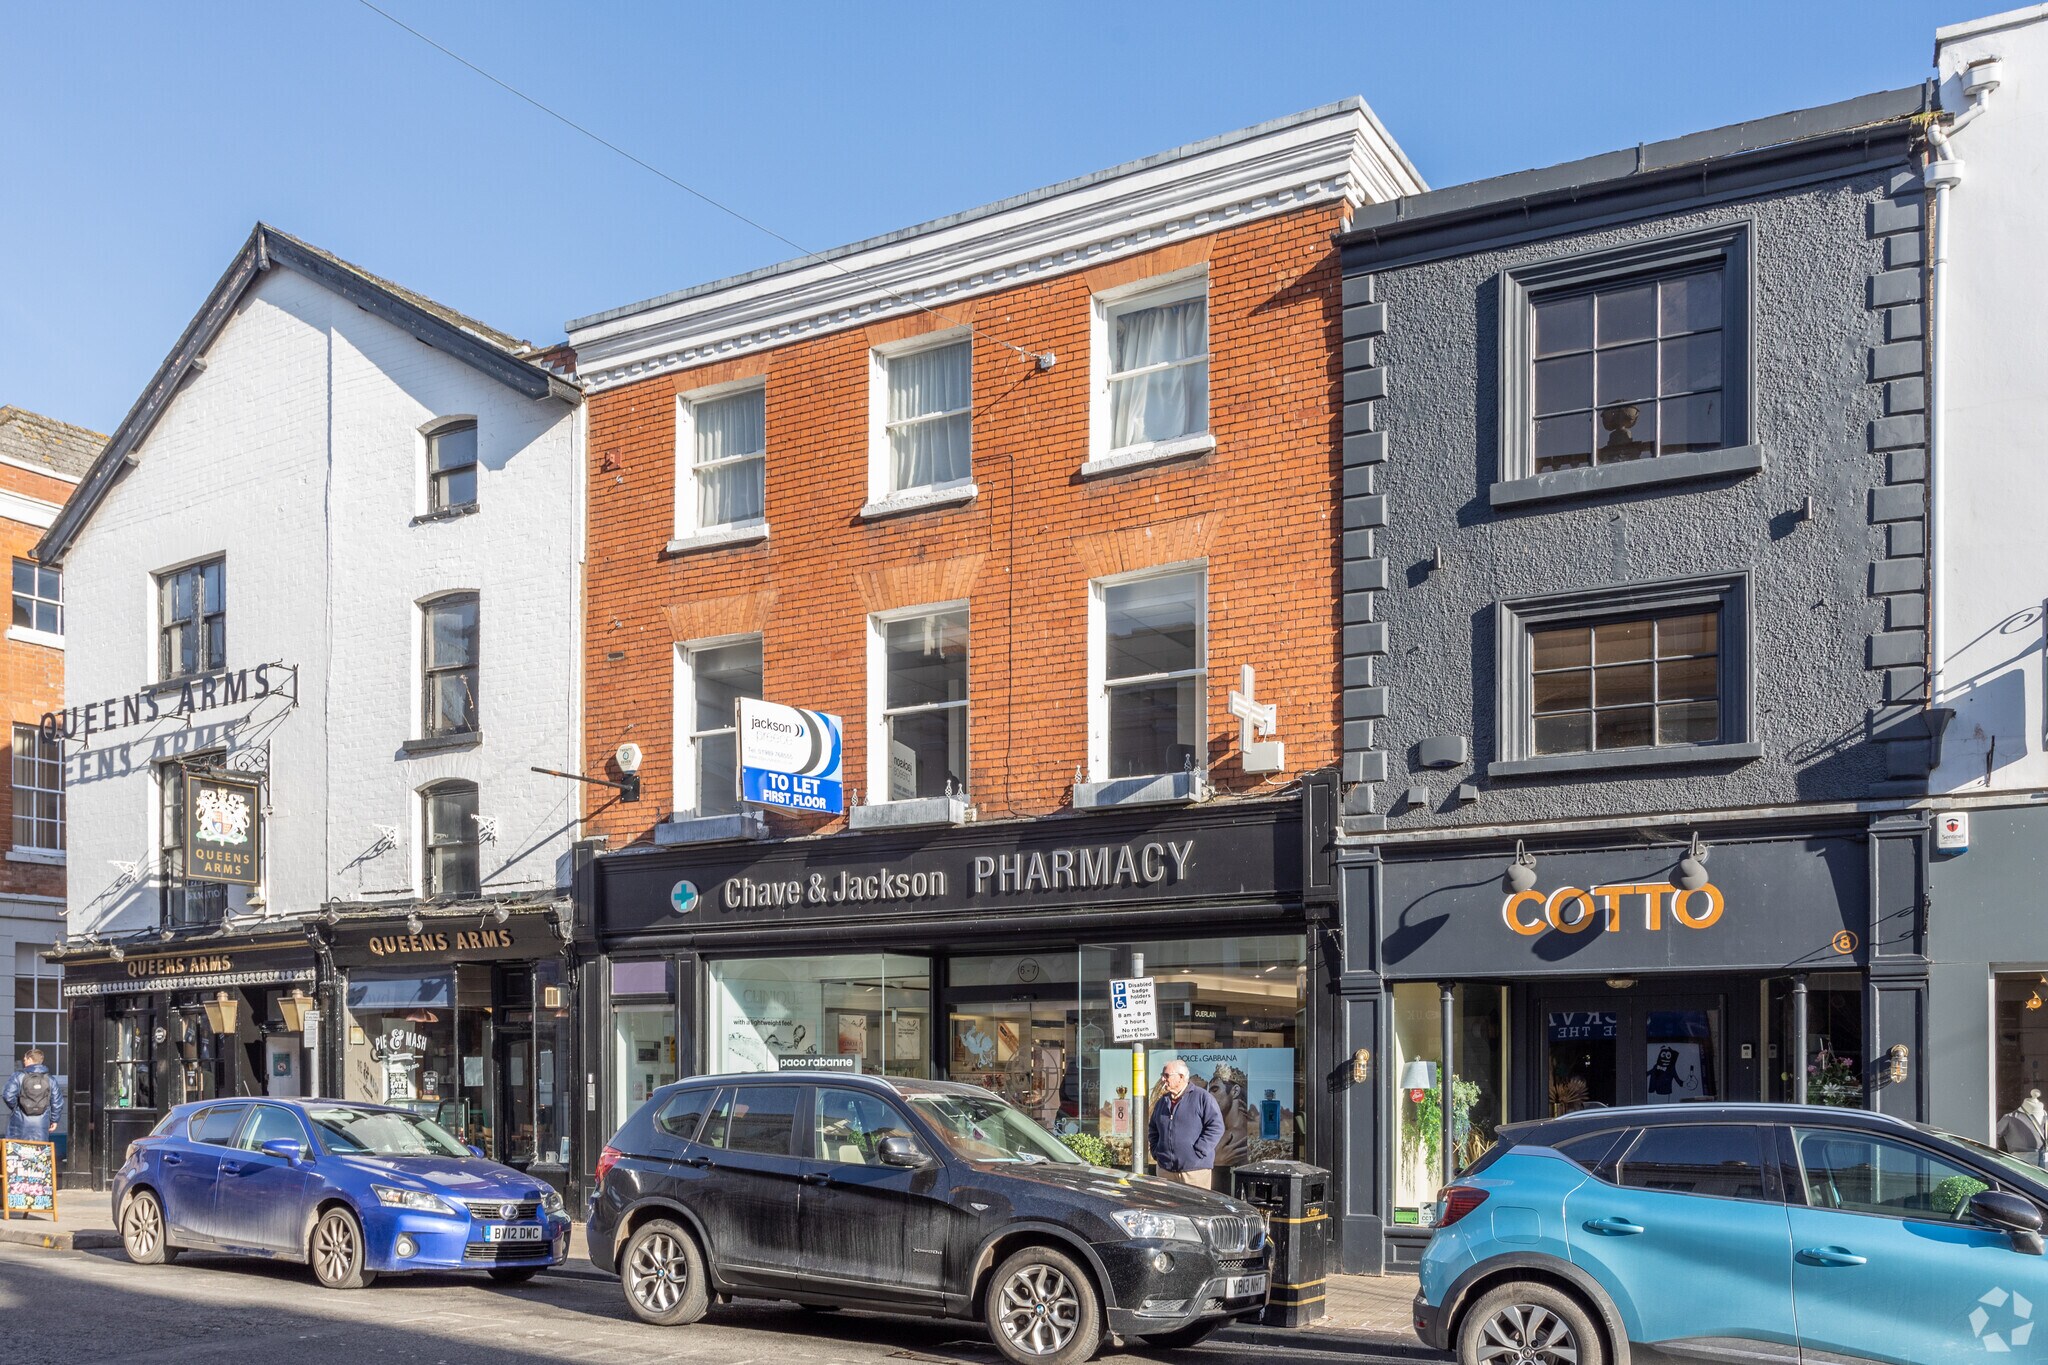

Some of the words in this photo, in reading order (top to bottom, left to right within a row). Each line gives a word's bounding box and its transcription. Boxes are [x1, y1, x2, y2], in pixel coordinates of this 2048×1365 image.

[40, 687, 159, 744] QUEENS
[177, 663, 269, 716] ARMS
[751, 715, 792, 733] jackson
[769, 772, 789, 791] TO
[793, 776, 820, 795] LET
[763, 789, 791, 804] FIRST
[793, 794, 827, 810] FLOOR
[195, 849, 250, 865] QUEENS
[204, 862, 242, 875] ARMS
[724, 877, 801, 909] Chave
[807, 872, 827, 903] &
[832, 867, 947, 901] Jackson
[975, 840, 1195, 894] PHARMACY
[1502, 881, 1725, 936] COTTO
[368, 931, 449, 956] QUEENS
[456, 929, 512, 950] ARMS
[127, 958, 186, 977] QUEENS
[189, 954, 233, 973] ARMS
[1115, 983, 1124, 994] P
[751, 1019, 782, 1027] lightweight
[1195, 1010, 1217, 1018] GUERLAIN
[375, 1034, 387, 1051] PIE
[390, 1029, 404, 1050] &
[405, 1031, 427, 1051] MASH
[780, 1056, 806, 1070] paco
[808, 1055, 853, 1068] rabanne
[495, 1227, 517, 1239] BV12
[520, 1227, 539, 1239] DWC
[1233, 1278, 1250, 1295] YB13
[1251, 1277, 1263, 1293] NHT
